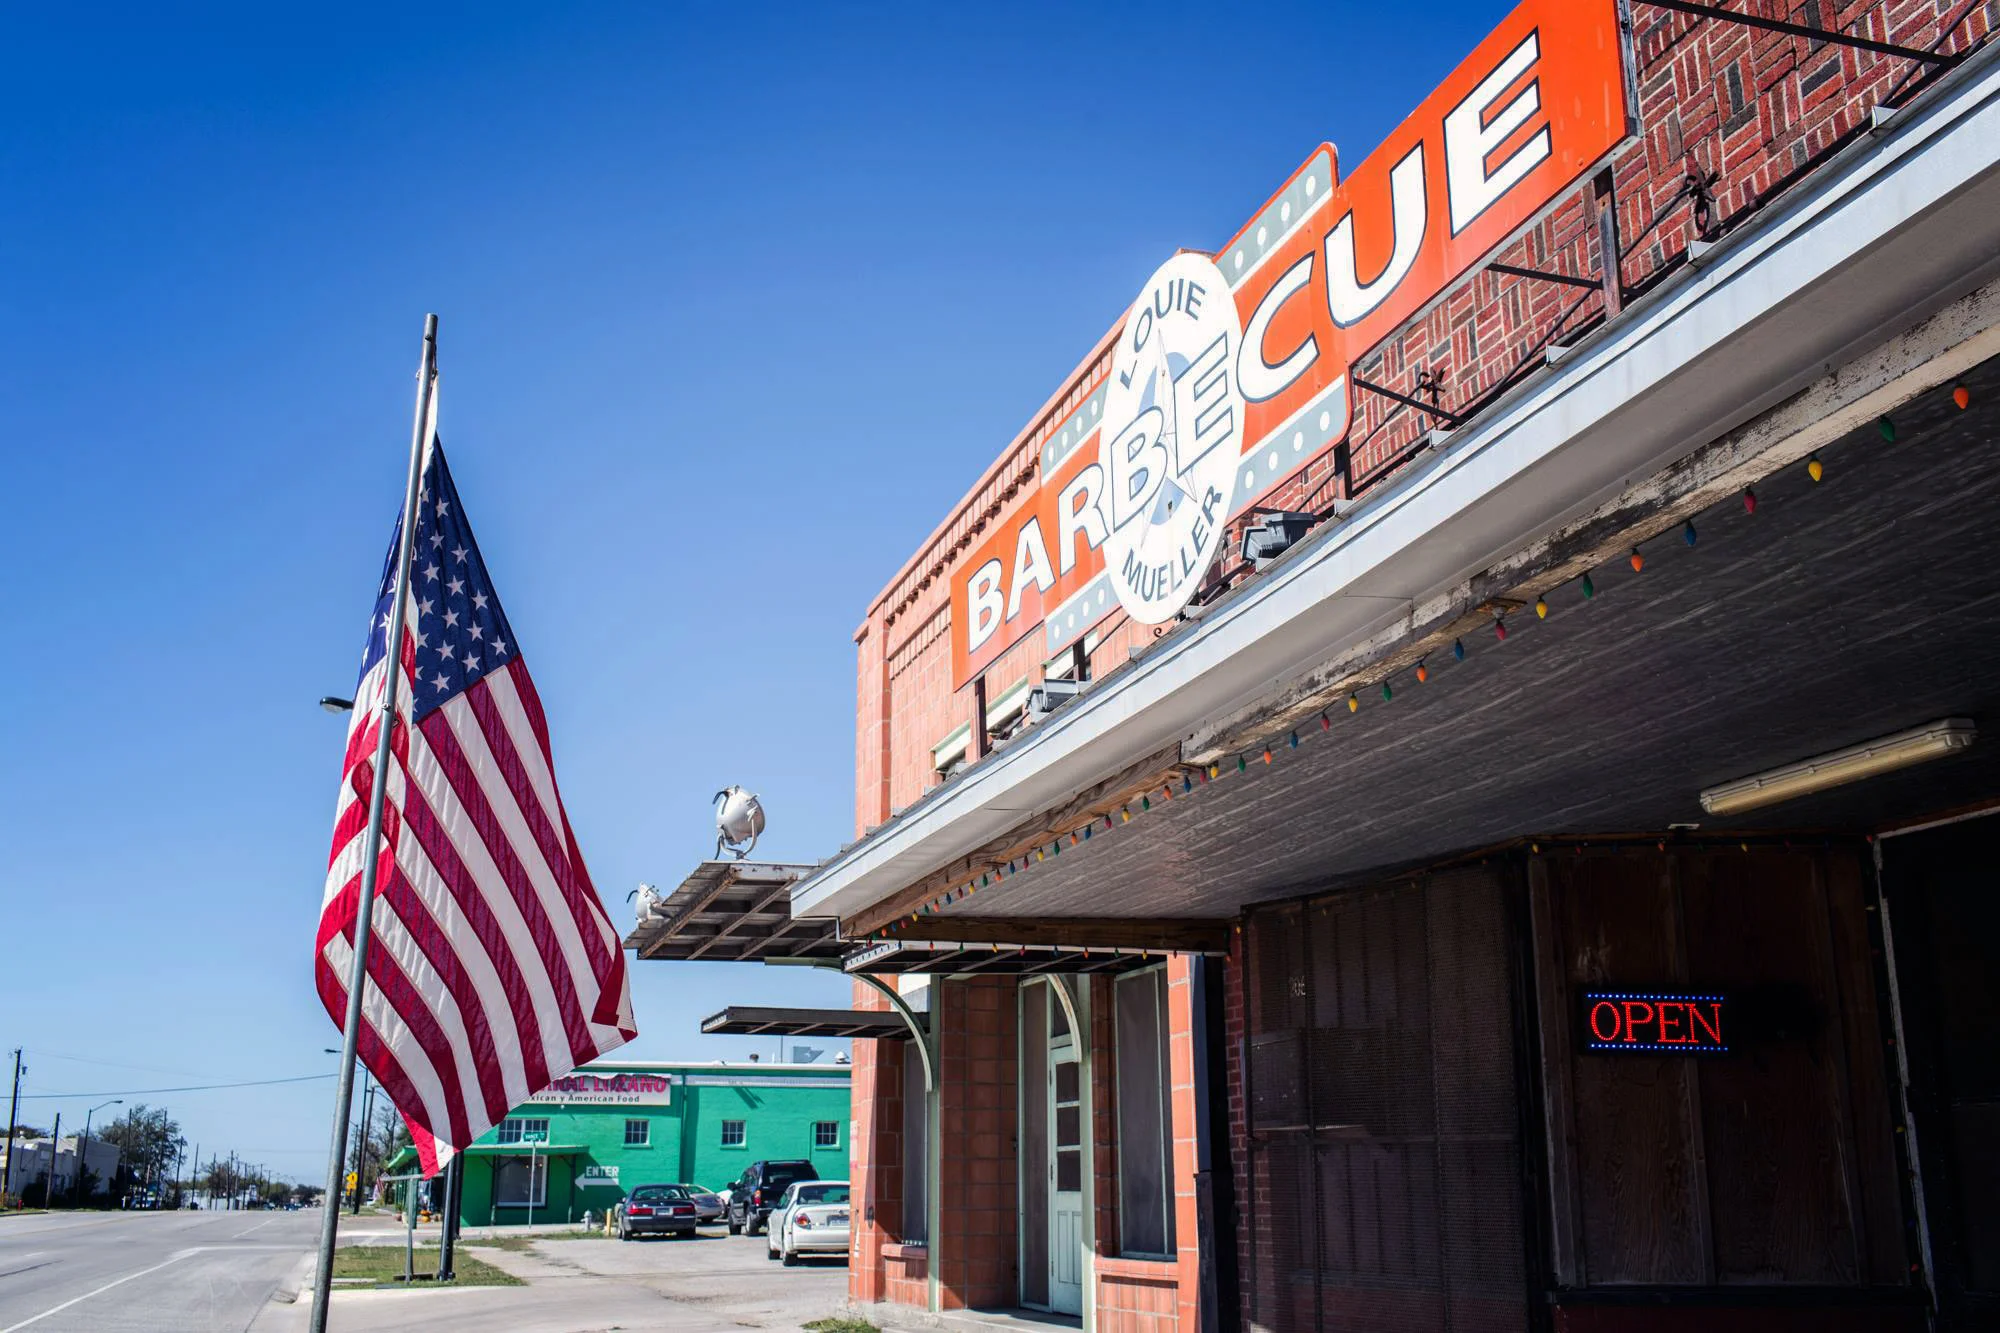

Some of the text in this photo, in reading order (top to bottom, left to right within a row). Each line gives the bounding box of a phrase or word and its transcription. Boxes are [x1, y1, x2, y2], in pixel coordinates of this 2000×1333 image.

[967, 26, 1553, 655] BARBECUE
[1119, 278, 1206, 391] LOUIE
[1122, 485, 1223, 602] MUELLER
[1590, 1001, 1722, 1044] OPEN
[568, 1094, 614, 1103] American
[617, 1095, 640, 1103] Food
[593, 1077, 667, 1092] LOZANO
[586, 1165, 619, 1177] ENTER
